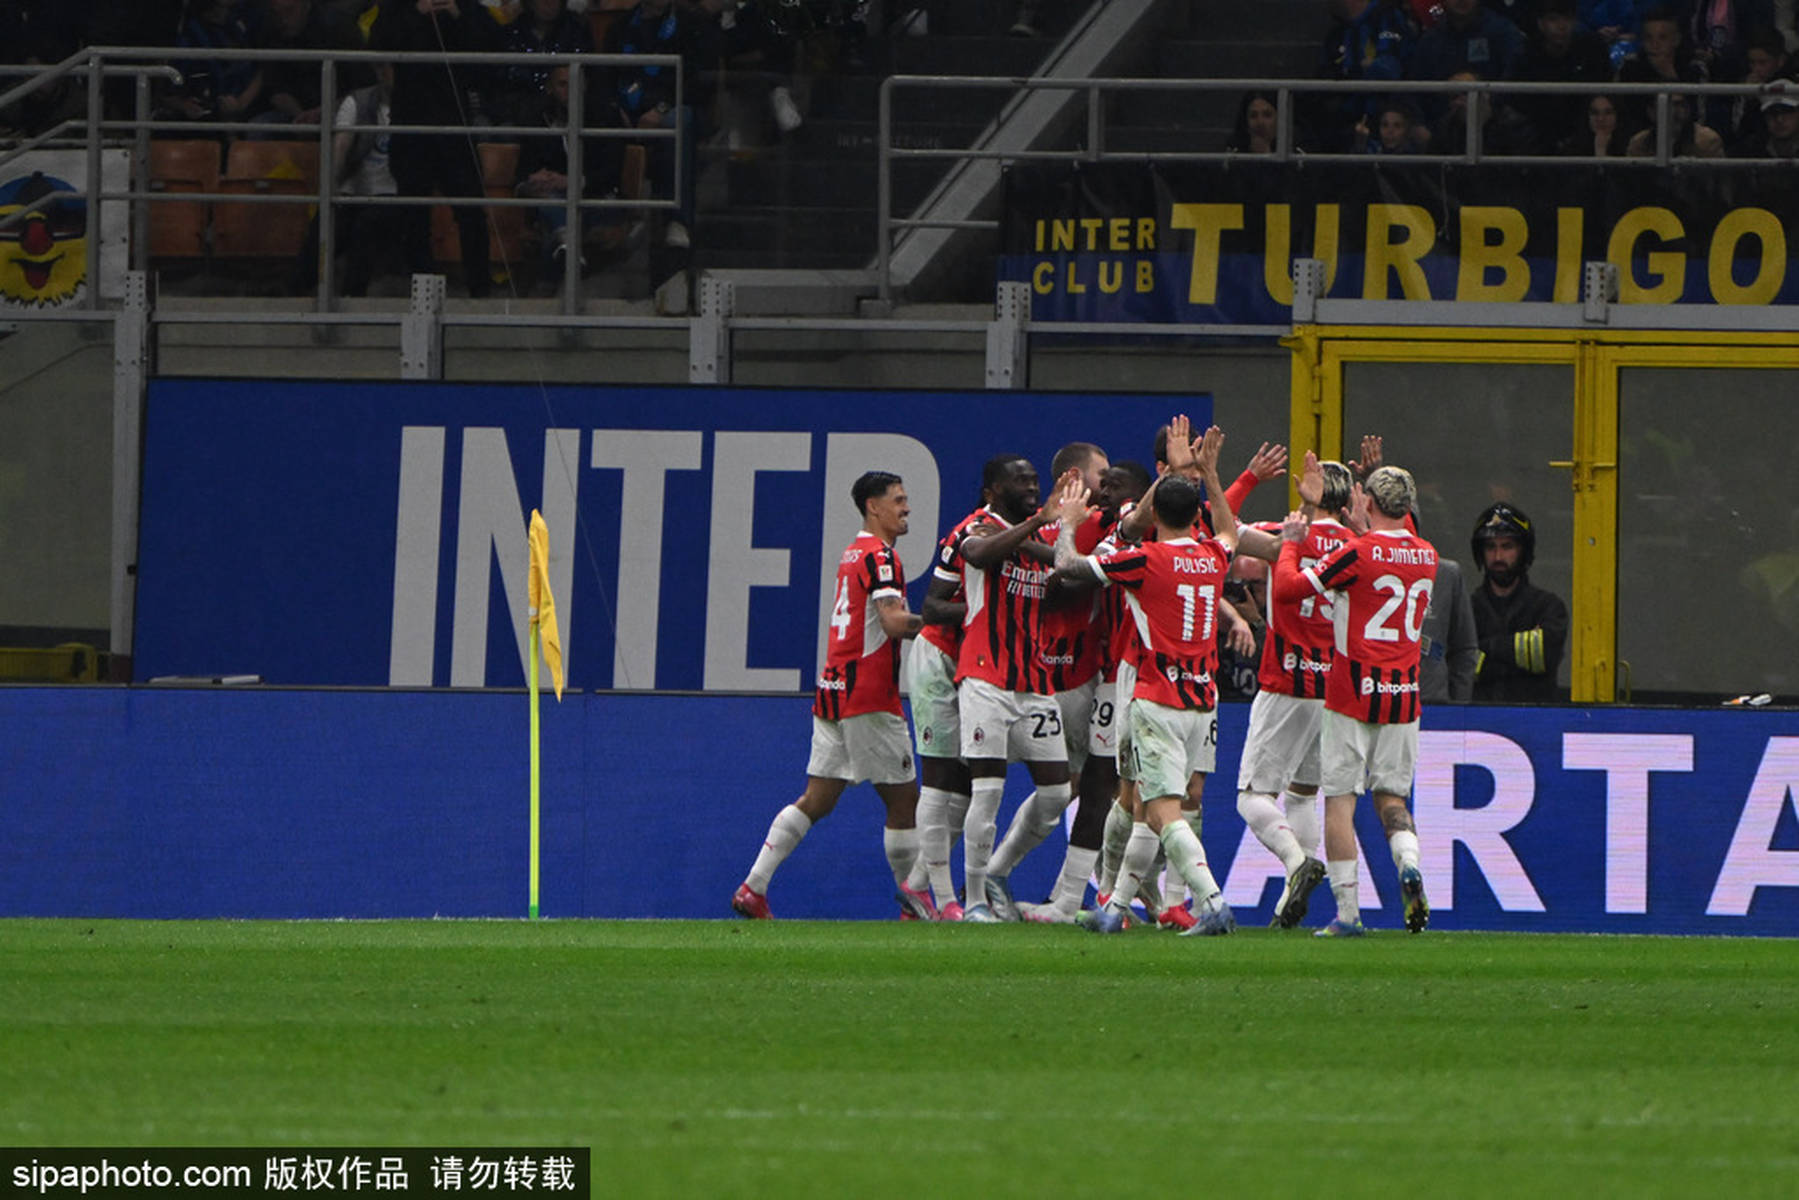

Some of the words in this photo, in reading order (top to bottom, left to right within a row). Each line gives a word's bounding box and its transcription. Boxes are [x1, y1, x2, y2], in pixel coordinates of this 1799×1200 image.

[1036, 217, 1156, 252] INTER
[1170, 202, 1787, 306] TURBIGO
[1033, 260, 1154, 294] CLUB
[388, 426, 941, 694] INTER
[1173, 556, 1219, 574] PULISIC
[831, 575, 851, 641] 4
[1176, 583, 1216, 642] 11
[1363, 574, 1433, 643] 20
[1030, 710, 1062, 738] 23
[1089, 698, 1114, 728] 29
